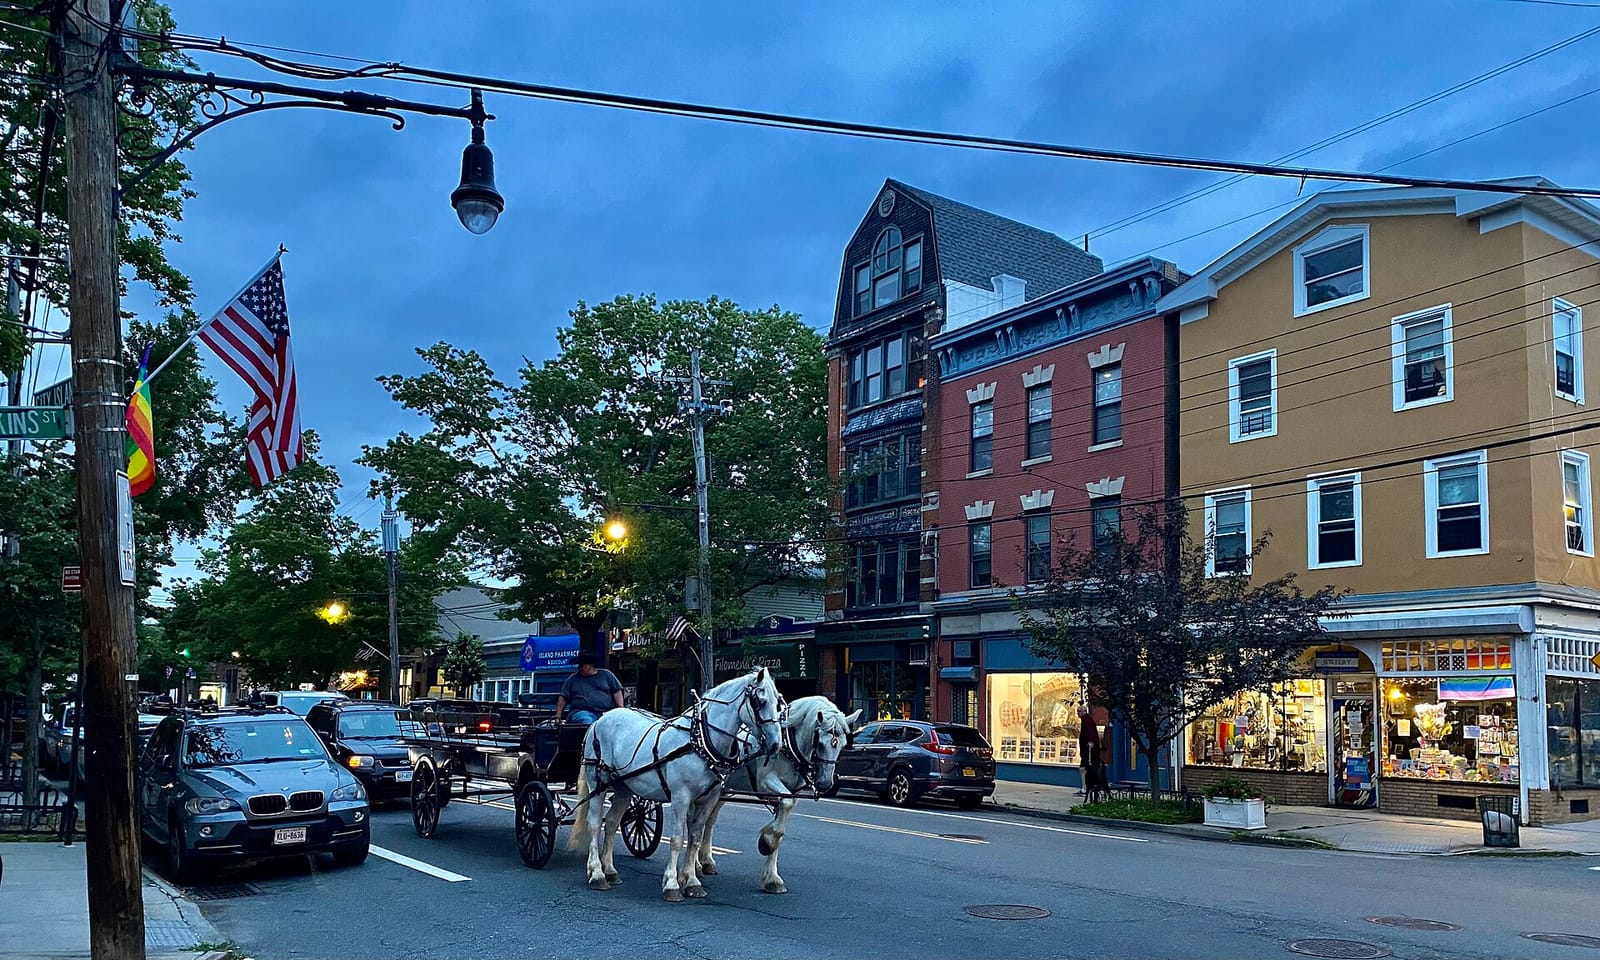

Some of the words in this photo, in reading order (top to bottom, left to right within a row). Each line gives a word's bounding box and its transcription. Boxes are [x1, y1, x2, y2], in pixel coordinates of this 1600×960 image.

[42, 411, 57, 423] ST
[538, 651, 554, 659] ISLAND
[554, 650, 580, 658] PHARMACY
